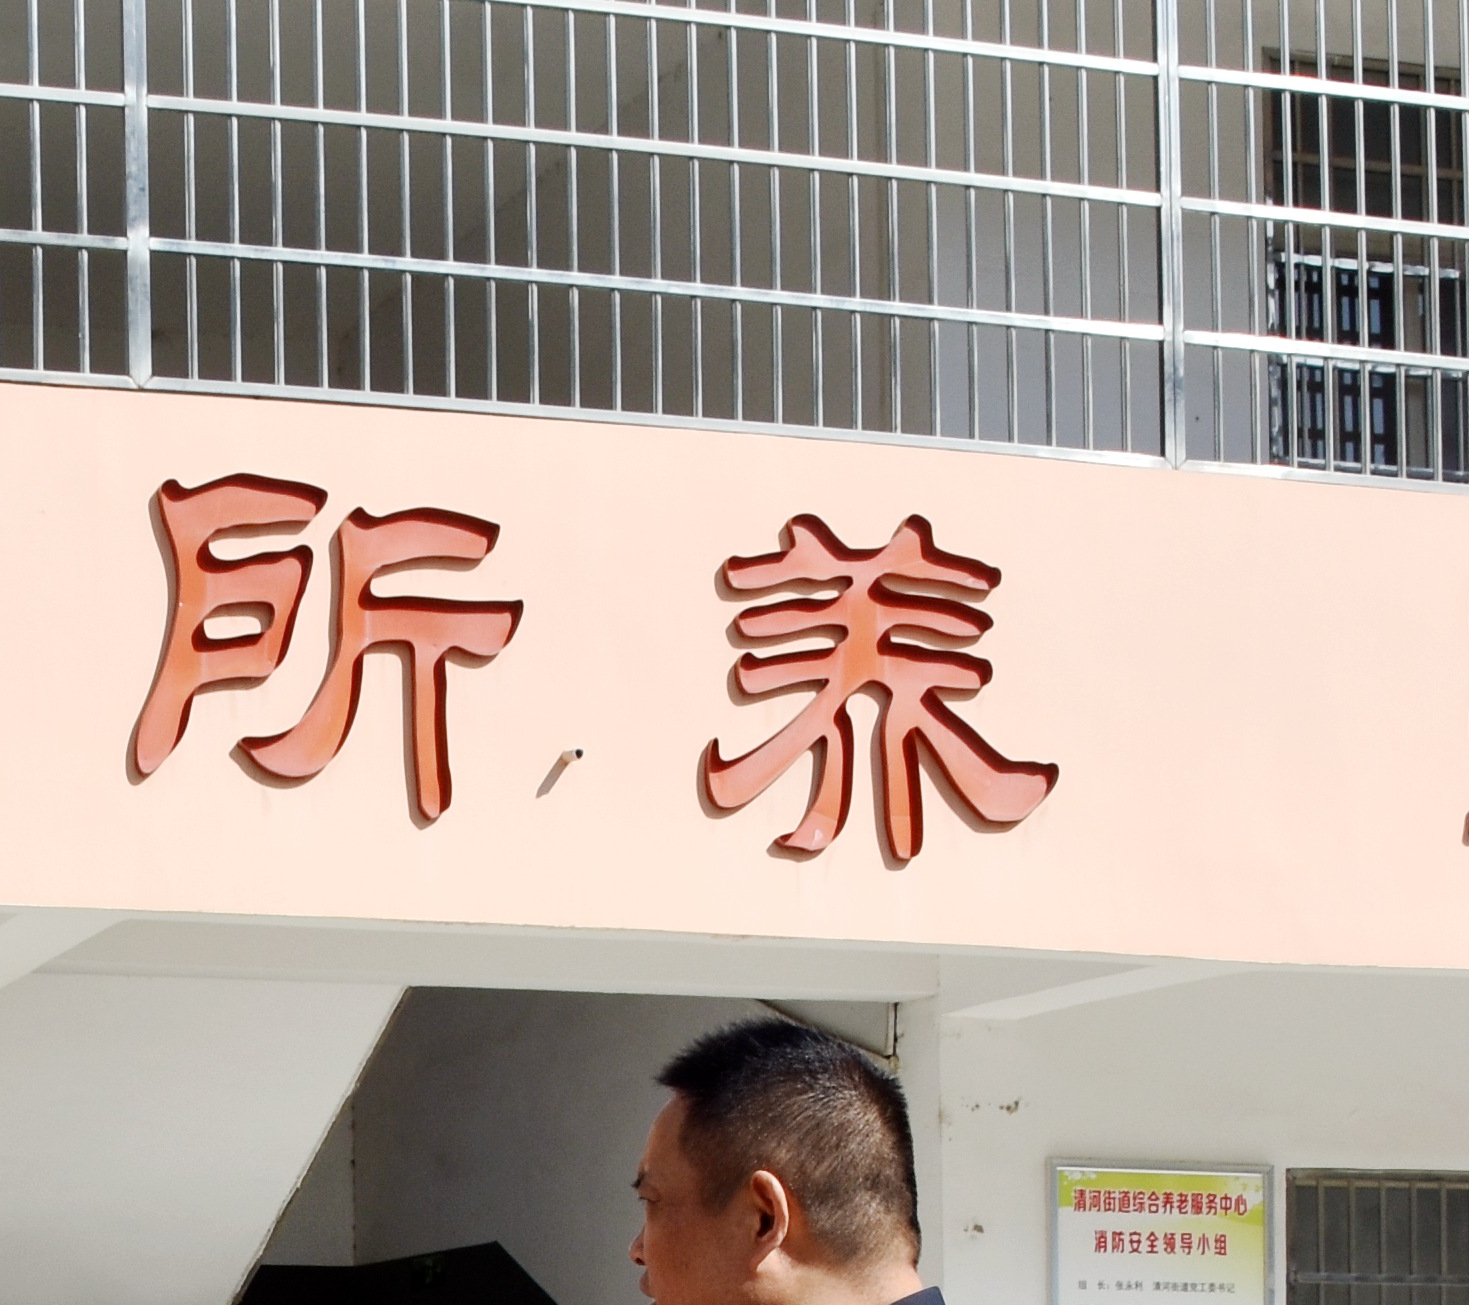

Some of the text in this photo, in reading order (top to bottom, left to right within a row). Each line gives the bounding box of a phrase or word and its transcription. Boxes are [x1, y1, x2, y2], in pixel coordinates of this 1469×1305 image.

[1073, 1188, 1248, 1216] 清河街道综合养老服务中心
[1094, 1230, 1228, 1256] 消防安全领导小组
